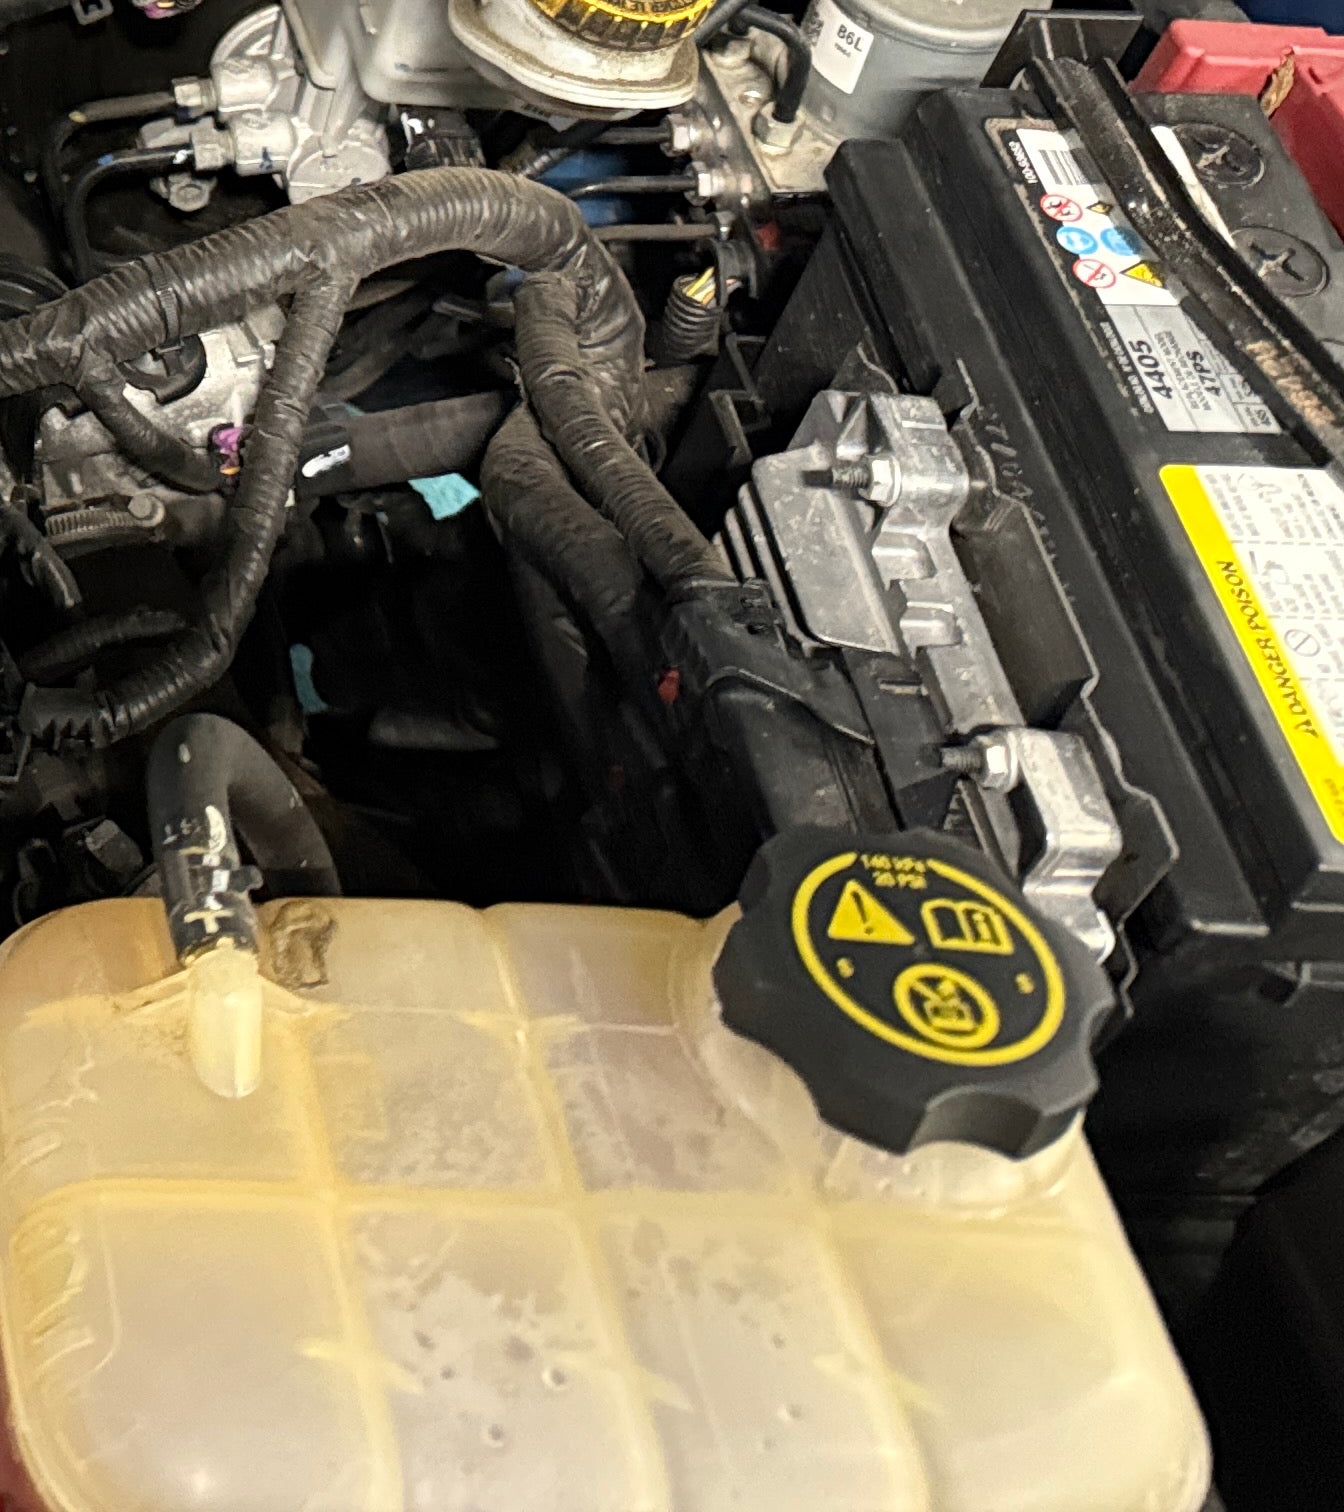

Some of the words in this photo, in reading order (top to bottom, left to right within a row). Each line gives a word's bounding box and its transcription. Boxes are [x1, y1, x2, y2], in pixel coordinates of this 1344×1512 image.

[1128, 339, 1173, 399] 4405
[1216, 560, 1267, 630] POISON
[1255, 637, 1307, 715] DANGER
